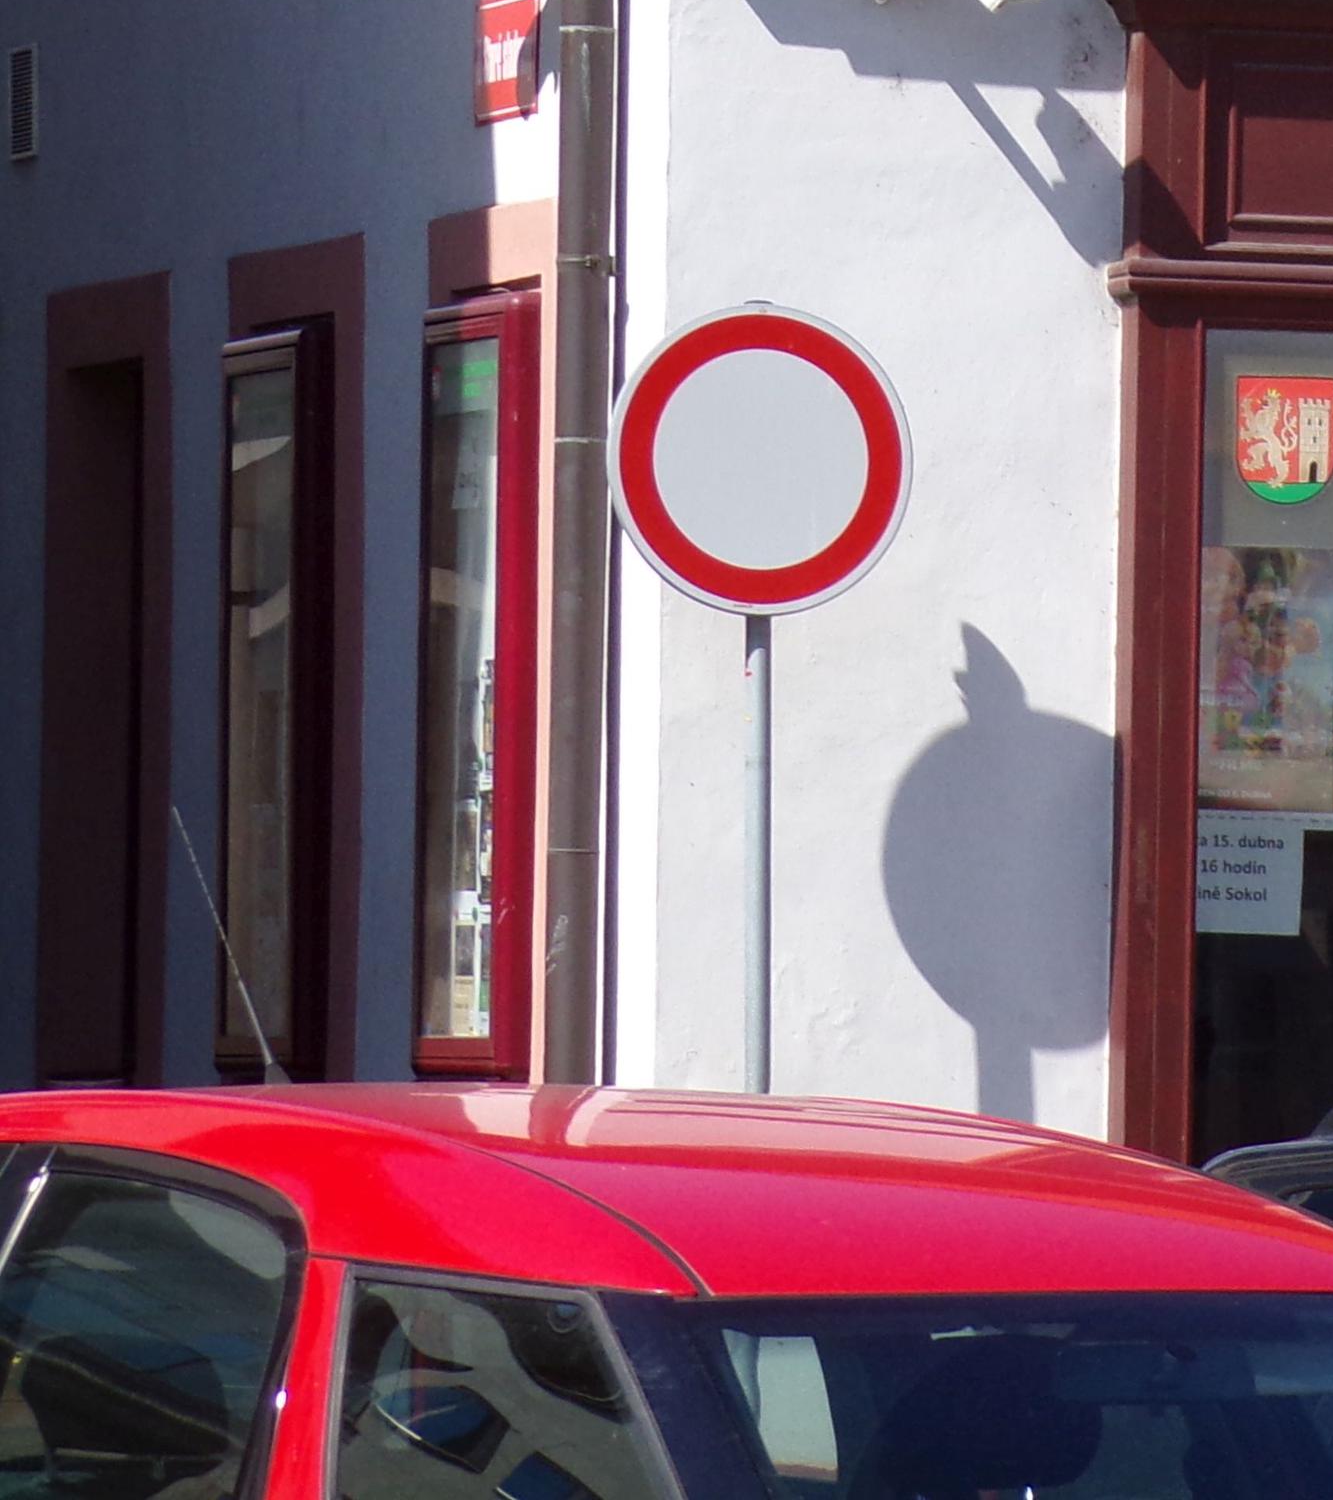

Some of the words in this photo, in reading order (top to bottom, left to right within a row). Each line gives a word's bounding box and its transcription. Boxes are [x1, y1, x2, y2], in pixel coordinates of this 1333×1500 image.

[1213, 834, 1234, 848] 15.
[1238, 835, 1285, 849] dubna
[1200, 859, 1219, 873] 16
[1223, 860, 1267, 875] hodin
[1225, 887, 1267, 902] Sokol
